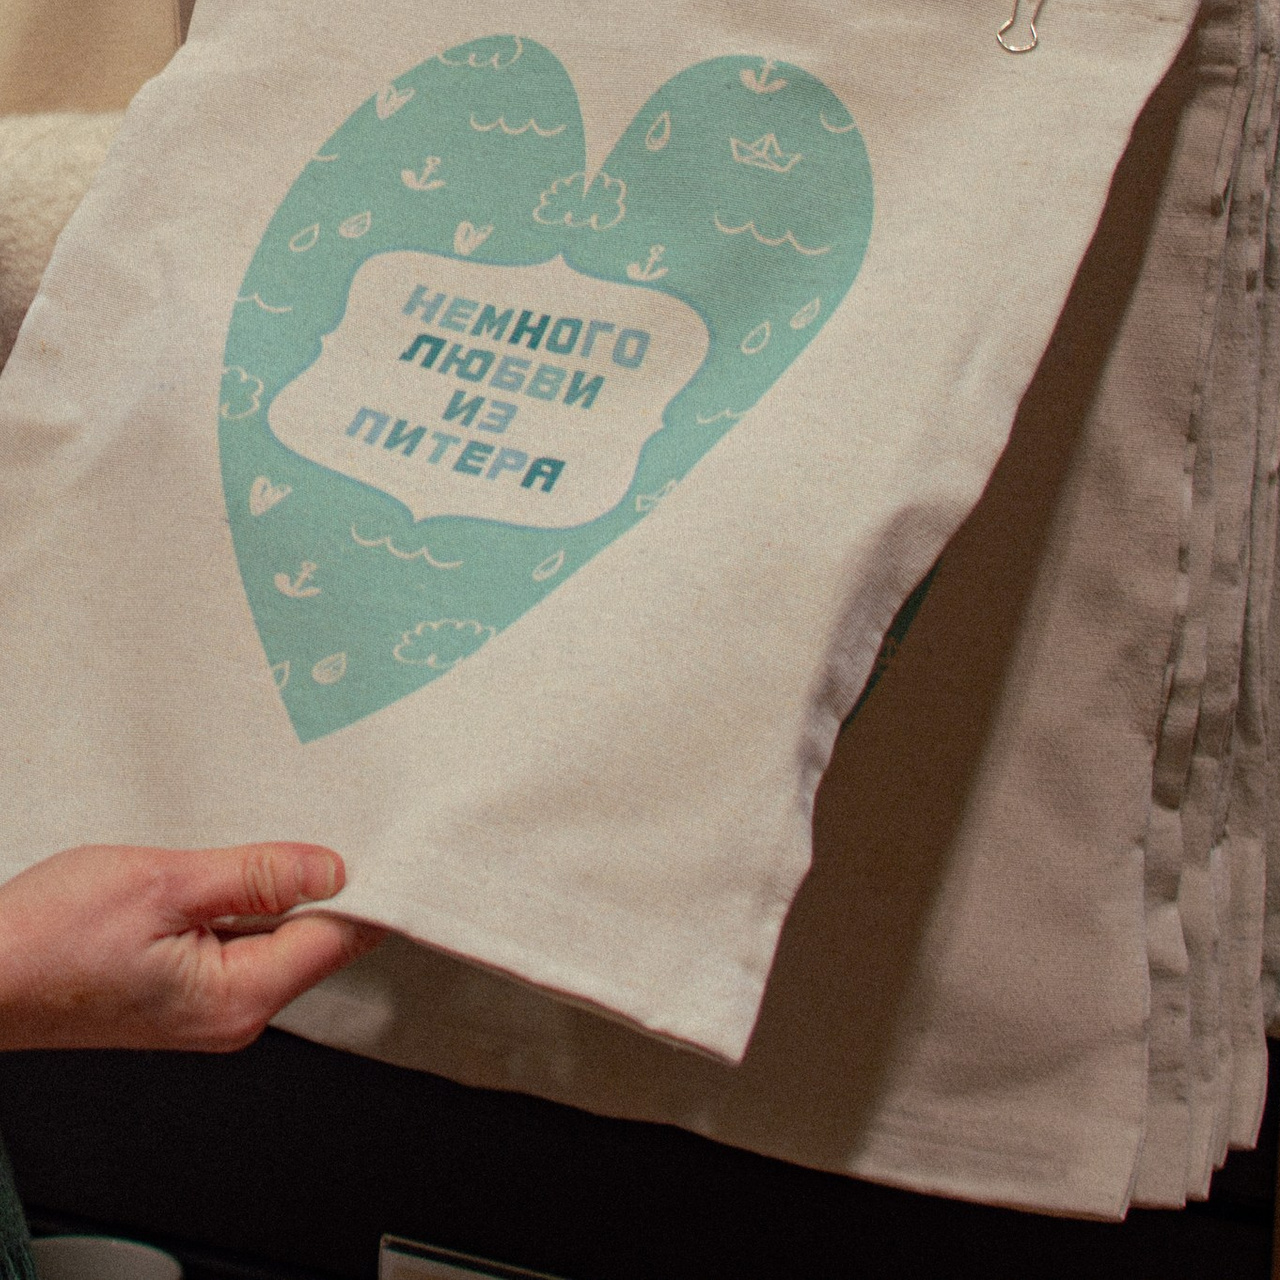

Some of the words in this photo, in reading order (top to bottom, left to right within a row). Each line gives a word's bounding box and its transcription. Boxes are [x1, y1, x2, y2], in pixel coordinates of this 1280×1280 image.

[403, 284, 651, 371] НЕМНОГО
[399, 332, 606, 410] ЛЮБВИ
[441, 389, 519, 434] ИЗ
[345, 407, 566, 493] ПИТЕРА
